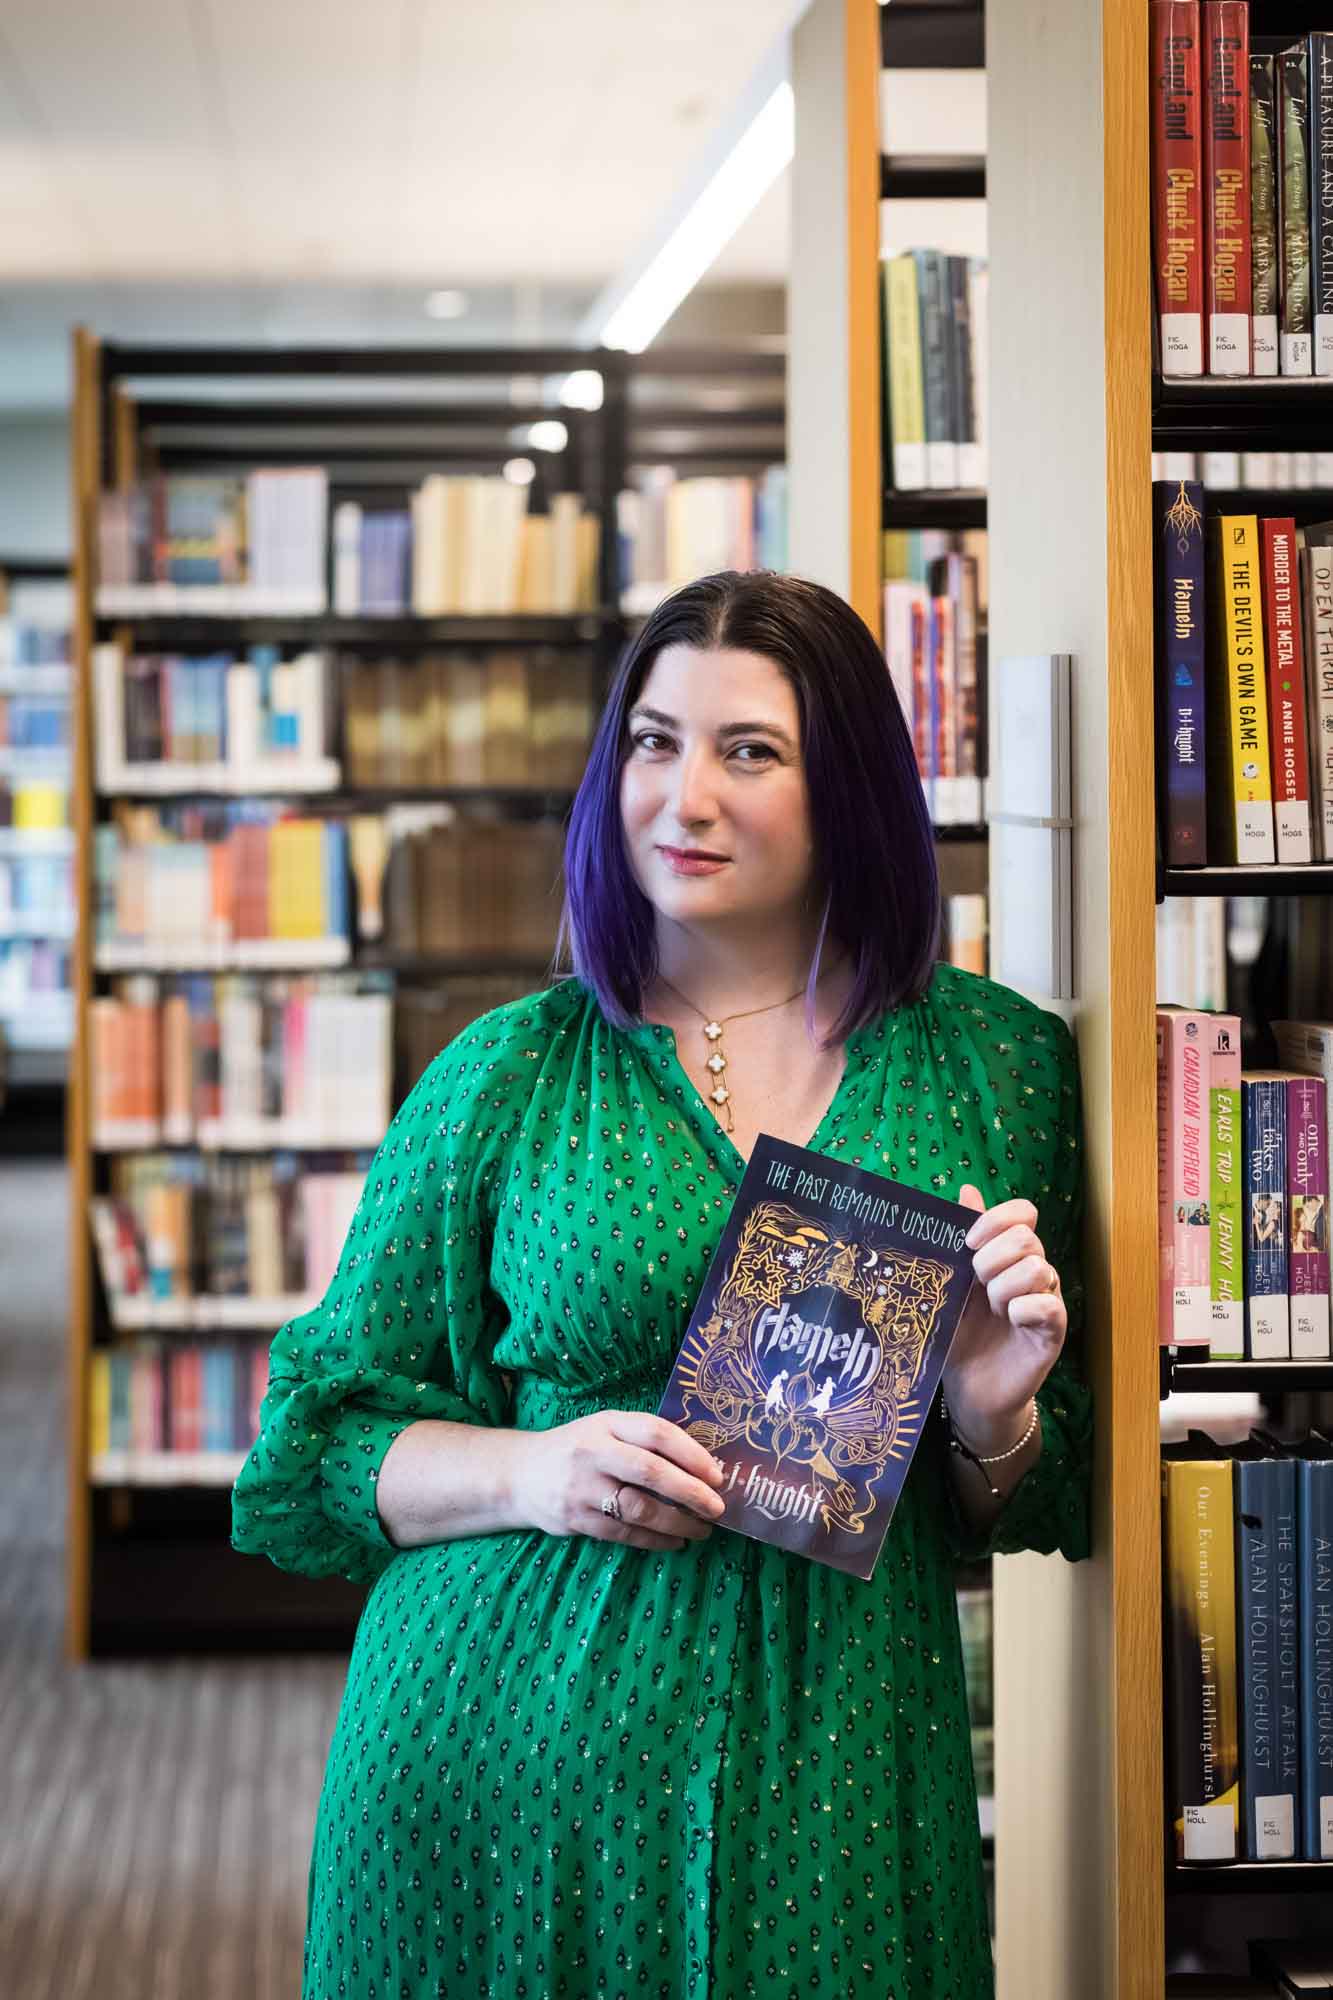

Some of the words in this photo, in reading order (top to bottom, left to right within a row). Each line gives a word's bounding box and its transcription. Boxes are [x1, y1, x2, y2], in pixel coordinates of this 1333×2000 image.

[1321, 75, 1333, 160] PLEASURE
[1166, 168, 1195, 231] Chuck
[1214, 168, 1243, 231] Chuck
[1321, 168, 1333, 208] AND
[1161, 238, 1194, 301] Hogan
[1211, 238, 1243, 301] Hogan
[1257, 235, 1273, 275] MARY
[1292, 233, 1307, 274] MARY
[1322, 235, 1333, 312] CALLING
[1292, 281, 1305, 333] HOGAN
[1232, 561, 1250, 590] THE
[1272, 534, 1291, 584] MURDER
[1174, 578, 1195, 639] Hameln
[1275, 587, 1292, 601] TO
[1275, 604, 1292, 627] THE
[1315, 567, 1333, 619] OPEN
[1234, 596, 1254, 656] DEVIL'S
[1276, 629, 1294, 670] METAL
[1237, 663, 1255, 700] OWN
[1239, 705, 1258, 751] GAME
[1282, 700, 1295, 744] ANNIE
[1183, 1046, 1200, 1120] CANADIAN
[1216, 1093, 1232, 1144] EARLS
[1308, 1124, 1319, 1157] one
[1183, 1123, 1200, 1197] BOYFRIEND
[1216, 1150, 1232, 1184] TRIP
[1252, 1150, 1263, 1181] two
[1263, 1128, 1279, 1172] takes
[1294, 1149, 1313, 1185] only
[766, 1160, 794, 1190] THE
[793, 1170, 831, 1204] PAST
[829, 1183, 900, 1228] REMAINS
[902, 1208, 967, 1253] UNSUNG
[1217, 1212, 1232, 1272] JENNY
[755, 1302, 881, 1390] Hameln
[1197, 1486, 1213, 1520] Our
[1278, 1514, 1292, 1552] THE
[1195, 1528, 1213, 1608] Evenings
[1250, 1537, 1268, 1593] ALAN
[1315, 1536, 1332, 1592] ALAN
[1278, 1562, 1294, 1691] SPARSHOLT
[1200, 1632, 1215, 1674] Alan
[1250, 1605, 1271, 1769] HOLLINGHURST
[1315, 1604, 1333, 1769] HOLLINGHURST
[1200, 1684, 1217, 1799] Hollinghurst
[1281, 1704, 1296, 1777] AFFAIR
